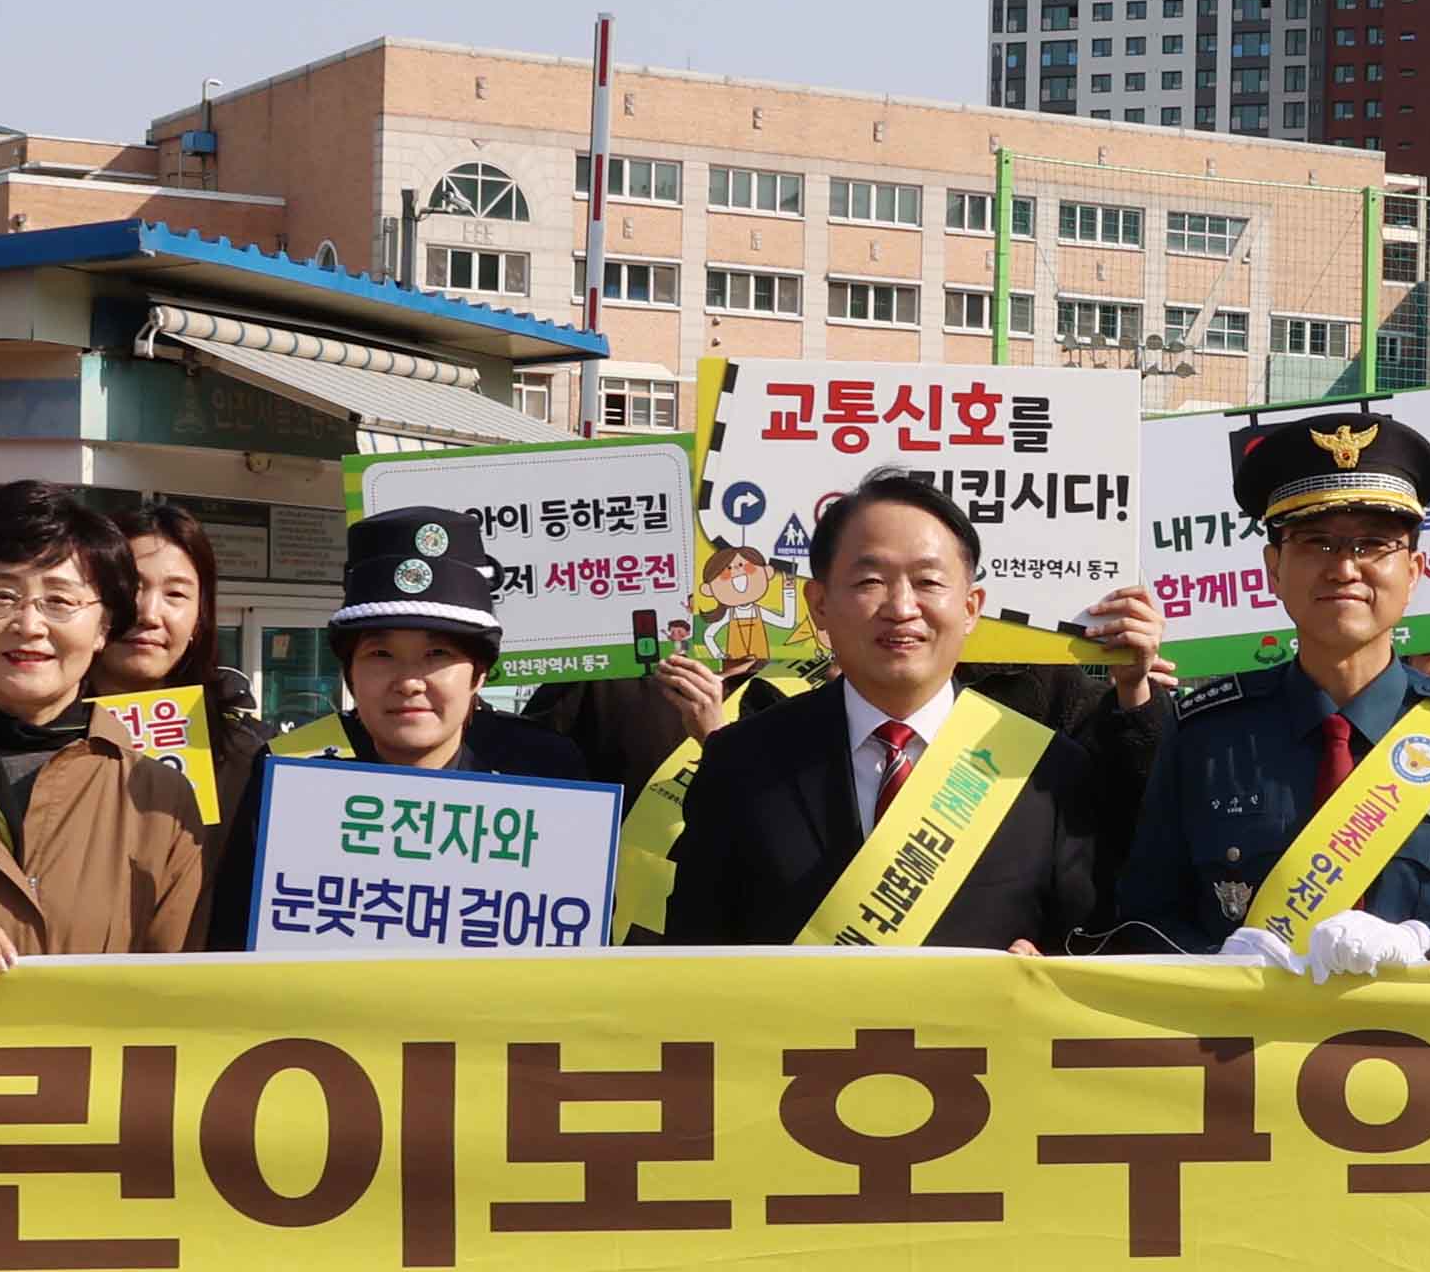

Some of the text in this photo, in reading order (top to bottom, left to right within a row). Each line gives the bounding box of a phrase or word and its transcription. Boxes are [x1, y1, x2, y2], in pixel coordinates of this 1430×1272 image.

[760, 380, 1053, 454] 교통신호를
[539, 493, 669, 537] 등하굣길
[544, 554, 678, 595] 서행운전
[991, 558, 1120, 580] 인천광역시 동구
[1154, 568, 1279, 618] 함께만
[502, 654, 610, 679] 인천광역시 동구
[340, 795, 539, 868] 운전자와
[1328, 783, 1403, 864] 스쿨존
[271, 872, 592, 947] 눈맞추며 걸어요
[859, 816, 955, 935] 교통법규
[1286, 853, 1343, 921] 안전
